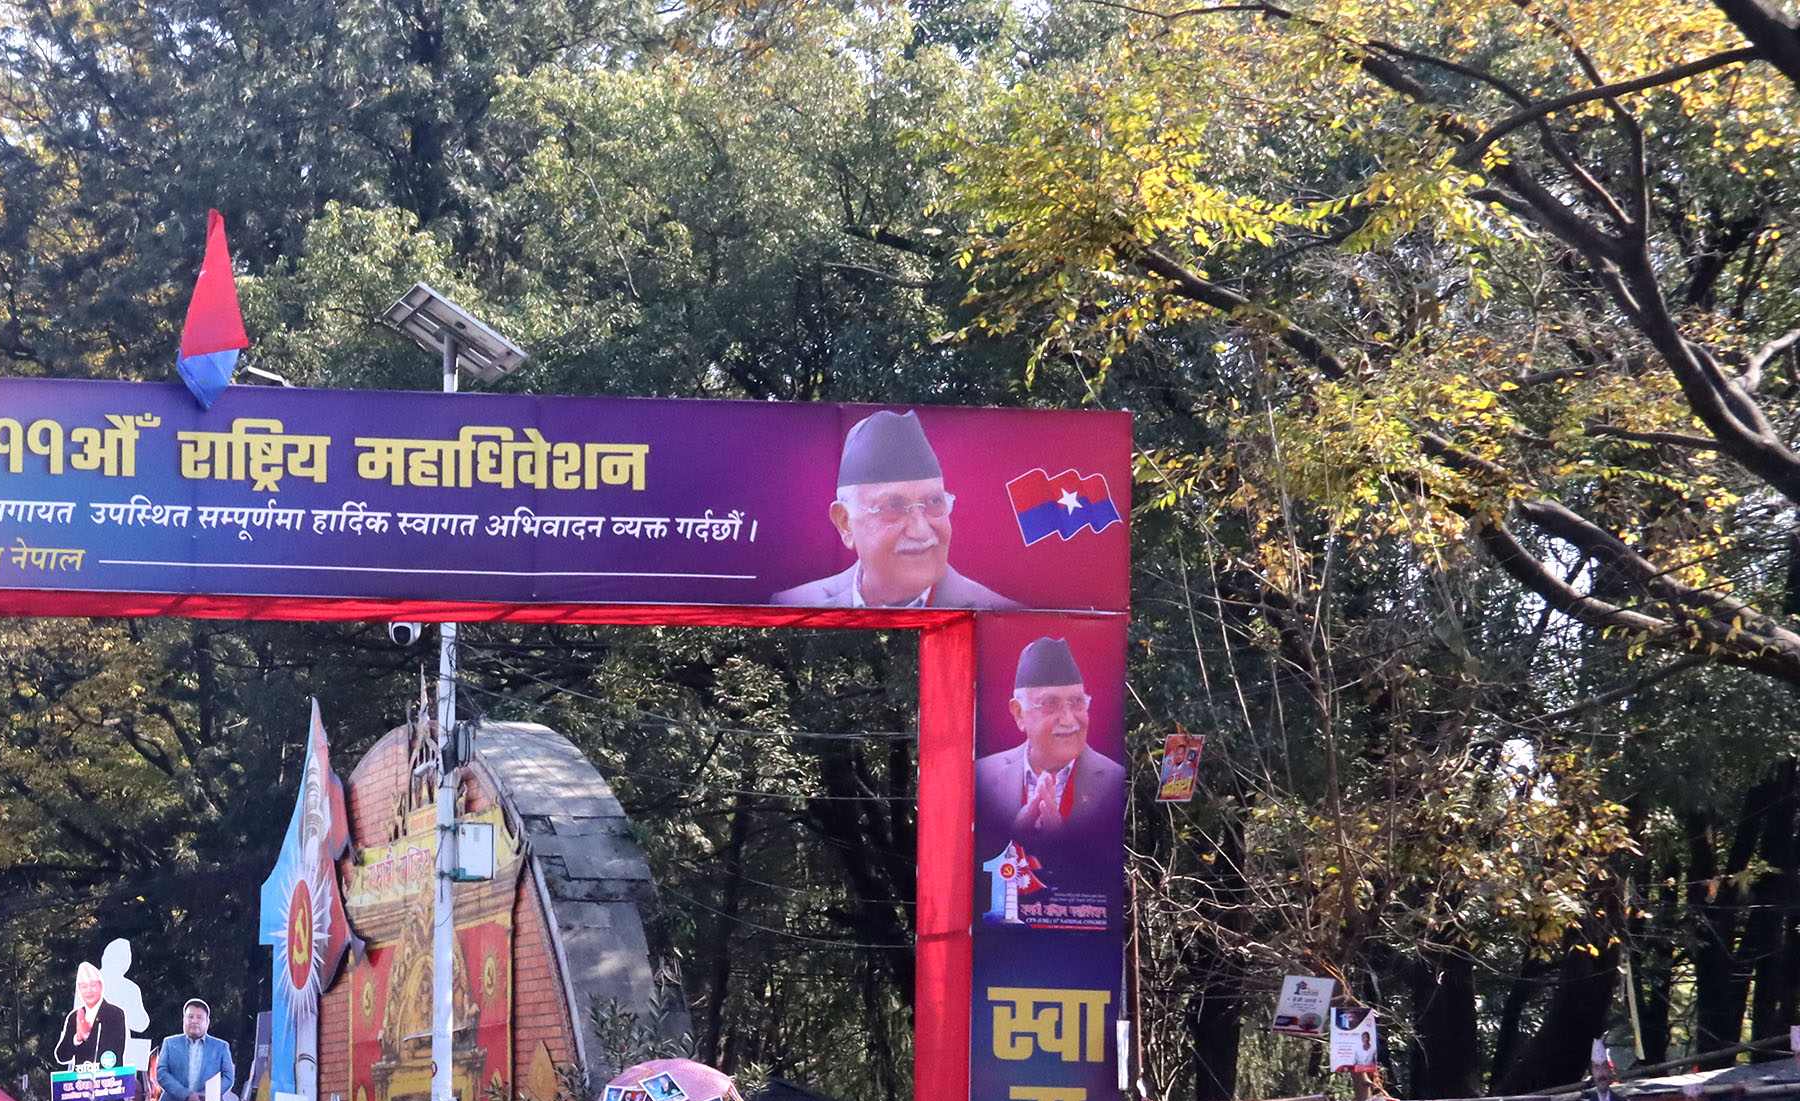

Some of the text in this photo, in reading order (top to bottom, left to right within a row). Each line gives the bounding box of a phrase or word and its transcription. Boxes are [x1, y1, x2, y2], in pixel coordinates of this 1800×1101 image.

[178, 419, 330, 491] राष्ट्रिय
[355, 426, 649, 490] महाधिवेशन
[90, 497, 187, 527] उपस्थित
[197, 501, 304, 541] सम्पूर्णमा
[313, 503, 389, 535] हार्दिक
[398, 513, 478, 536] स्वागत
[485, 508, 605, 540] अभिवादन
[611, 517, 670, 538] व्यक्त
[12, 538, 86, 572] नेपाल
